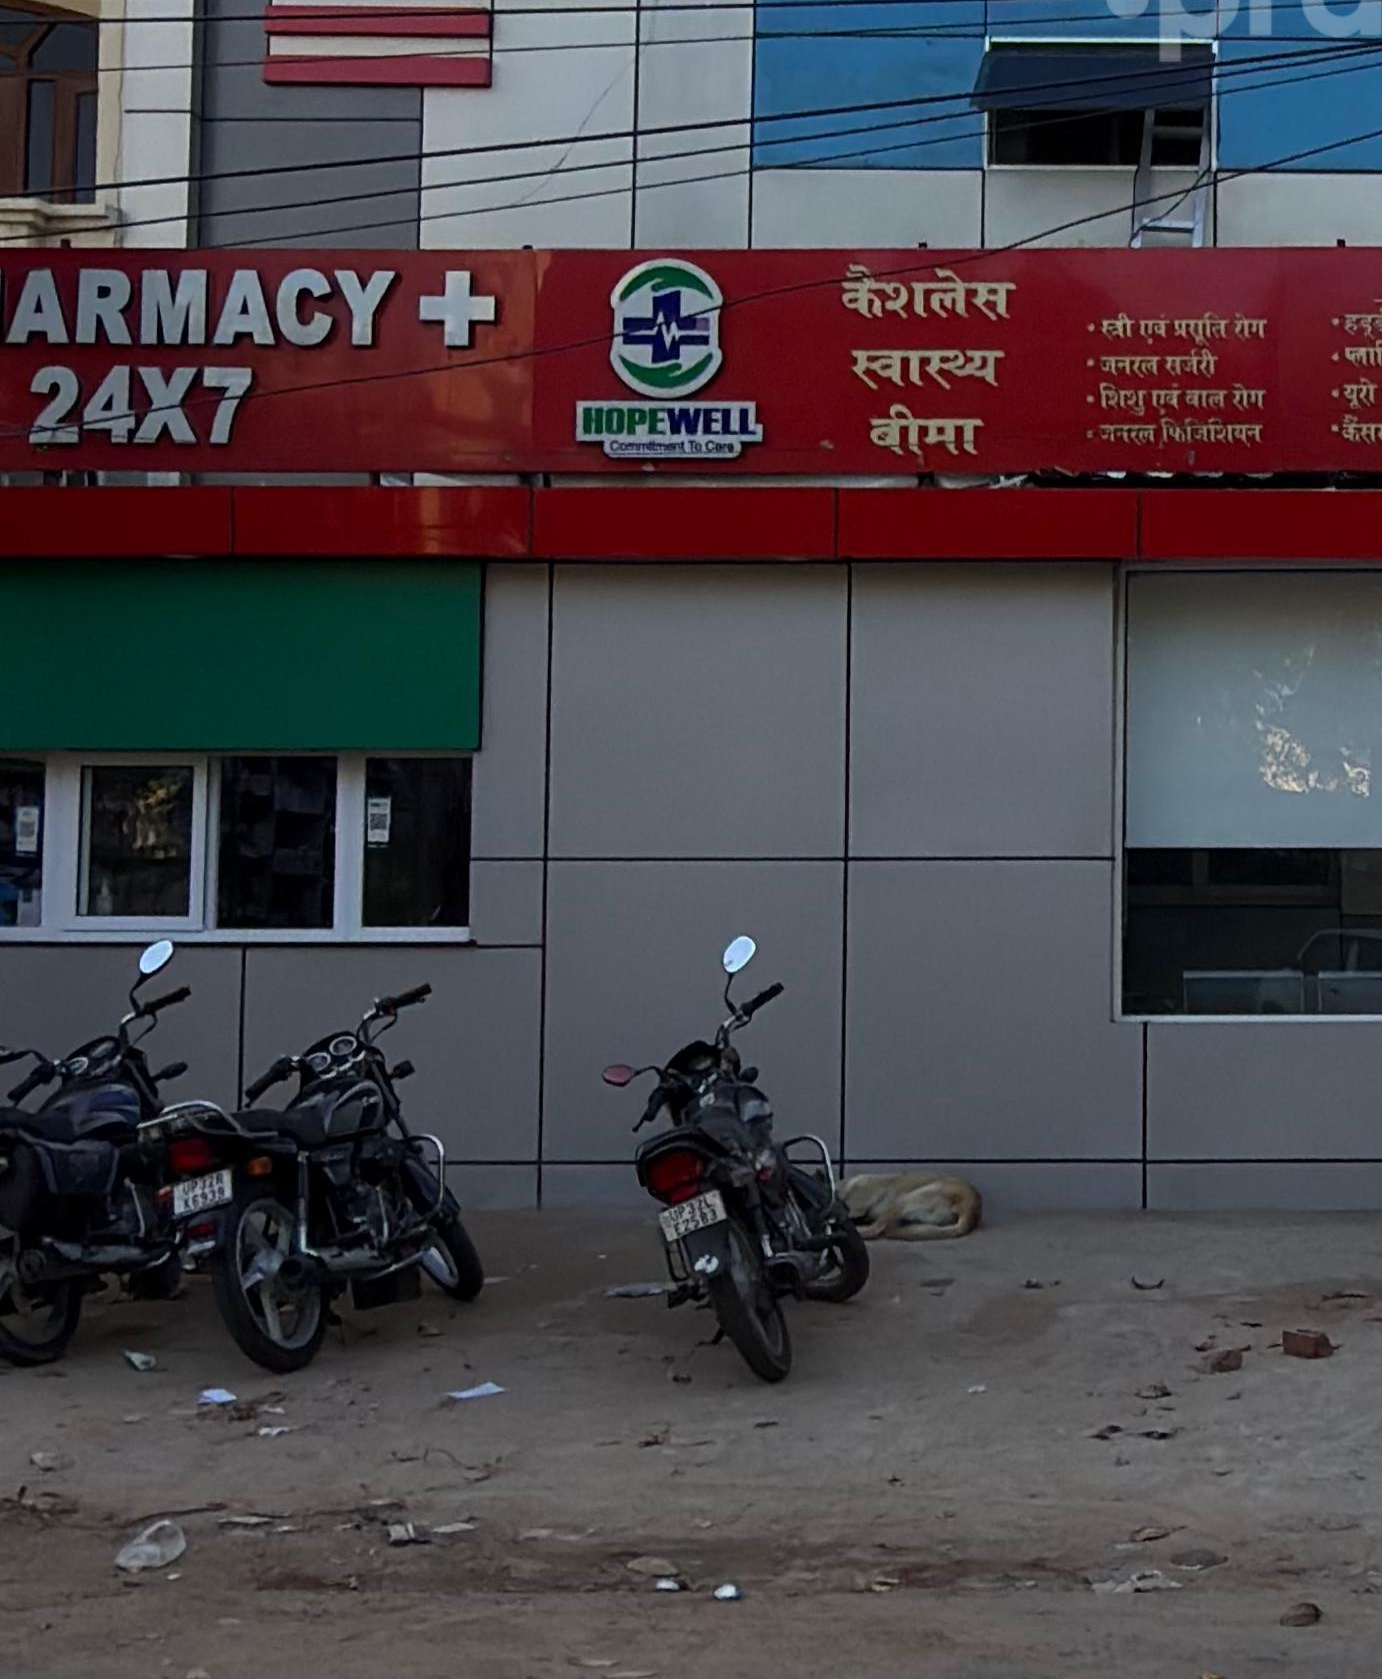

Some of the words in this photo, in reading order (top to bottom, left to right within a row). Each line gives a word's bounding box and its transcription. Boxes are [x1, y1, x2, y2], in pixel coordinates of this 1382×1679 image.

[841, 263, 1016, 321] कैशलेस
[1139, 313, 1170, 344] एवं
[1234, 312, 1267, 339] रोग
[850, 349, 1005, 390] स्वास्थ्य
[1100, 356, 1161, 378] जनरल
[1165, 348, 1219, 378] सर्जरी
[28, 365, 253, 444] 24X7
[1100, 382, 1146, 416] शिशु
[1151, 383, 1181, 415] एवं
[1232, 383, 1266, 411] रोग
[582, 407, 757, 436] HOPEWELL
[870, 404, 984, 455] बीमा
[609, 440, 684, 454] Commitment
[688, 440, 702, 453] To
[705, 440, 735, 454] Care
